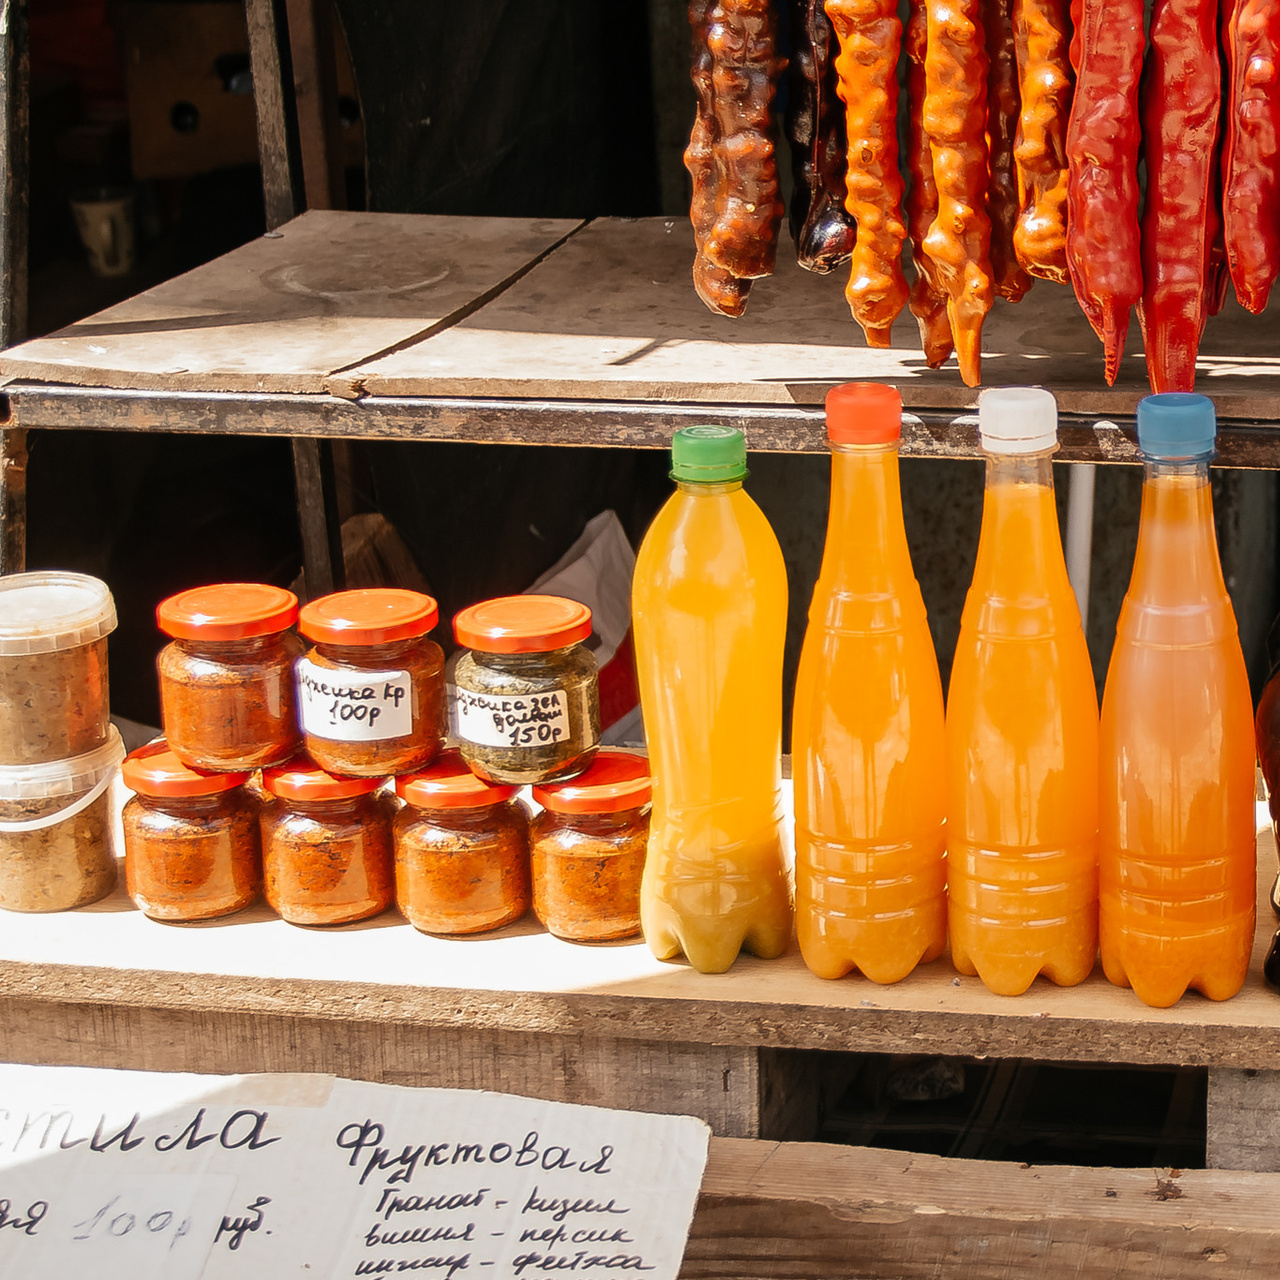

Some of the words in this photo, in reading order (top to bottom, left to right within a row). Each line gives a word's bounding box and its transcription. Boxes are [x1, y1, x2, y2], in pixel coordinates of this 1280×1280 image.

[0, 1107, 282, 1153] тила
[335, 1118, 616, 1186] Фруктовая
[518, 1223, 635, 1252] персик
